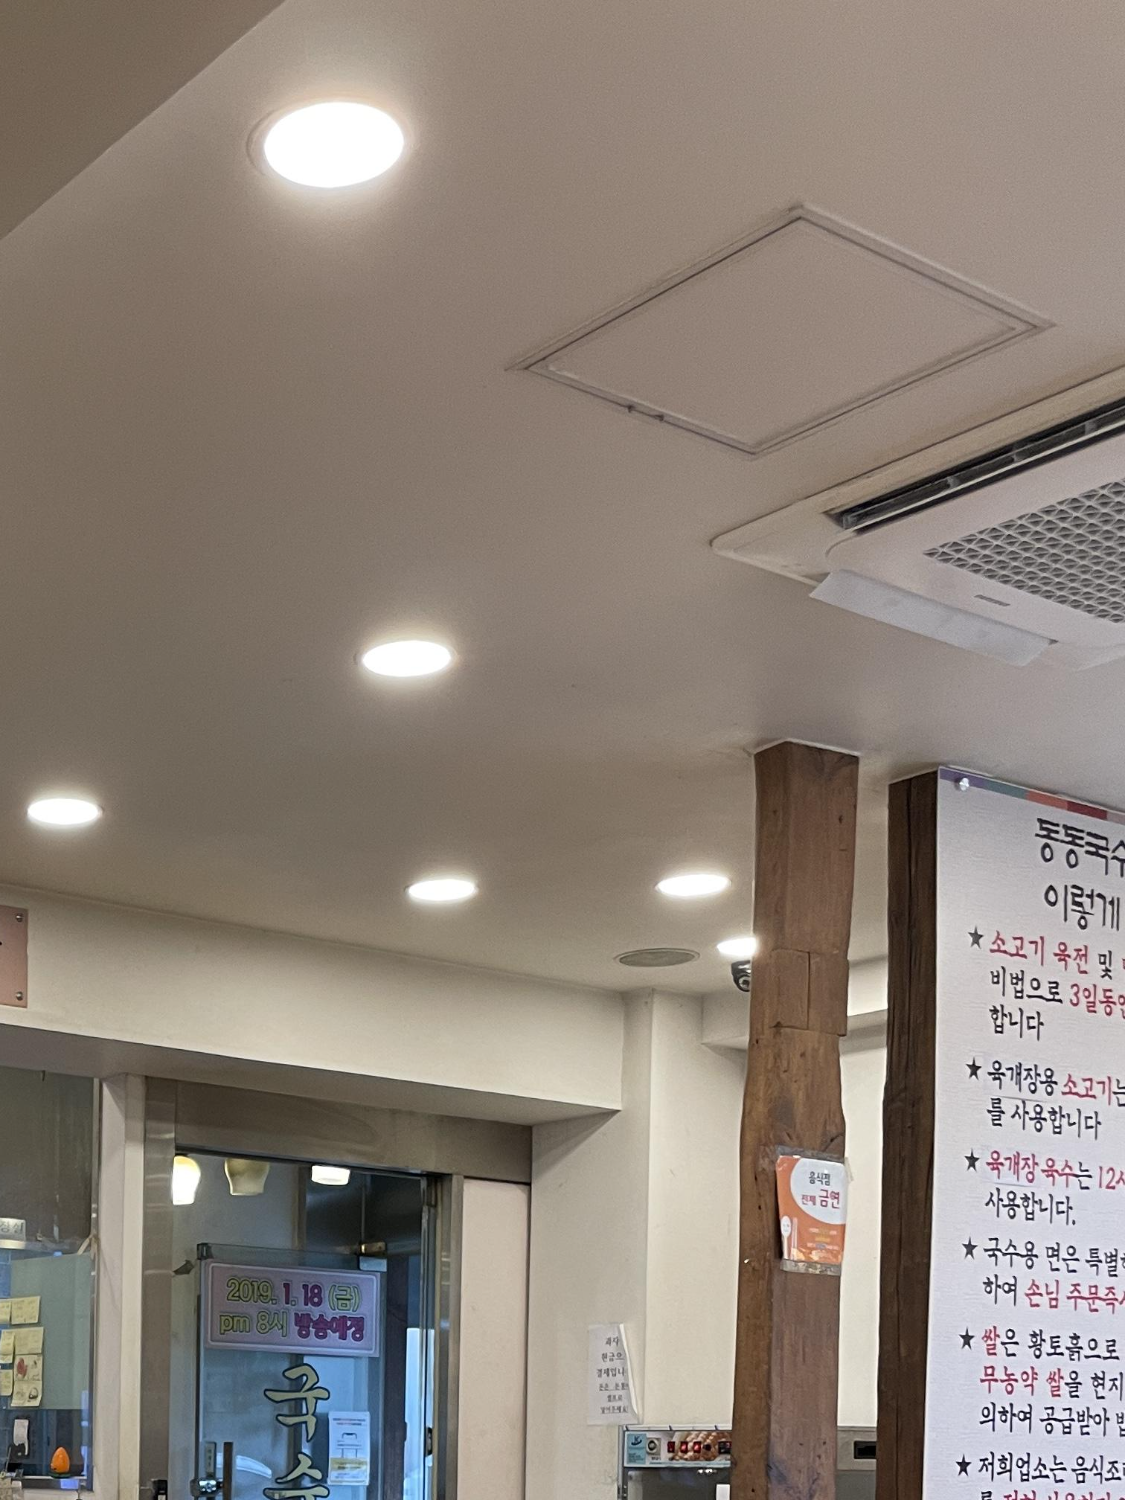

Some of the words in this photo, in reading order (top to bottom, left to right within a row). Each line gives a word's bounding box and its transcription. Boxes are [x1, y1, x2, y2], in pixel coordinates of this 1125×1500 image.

[1044, 884, 1121, 931] 이렇게
[990, 930, 1045, 967] 소고기
[1053, 941, 1090, 975] 육전
[1098, 950, 1113, 981] 및
[990, 966, 1063, 1004] 비법으로
[989, 1003, 1045, 1041] 합니다
[987, 1059, 1059, 1097] 육개장용
[1061, 1073, 1125, 1108] 소고기는
[987, 1097, 1006, 1127] 를
[1011, 1100, 1102, 1141] 사용합니다
[986, 1150, 1039, 1184] 육개장
[1041, 1157, 1093, 1191] 육수는
[985, 1187, 1077, 1226] 사용합니다.
[983, 1237, 1039, 1270] 국수용
[1045, 1242, 1080, 1274] 면은
[301, 1283, 323, 1308] 18
[328, 1283, 362, 1313] (금)
[983, 1274, 1017, 1307] 하여
[1025, 1279, 1060, 1310] 손님
[219, 1314, 251, 1336] pm
[256, 1311, 288, 1338] 8시
[294, 1312, 366, 1342] 방송예정
[981, 1326, 1020, 1358] 쌀은
[1028, 1329, 1120, 1362] 황토흙으로
[596, 1367, 625, 1378] 결제입니
[979, 1365, 1038, 1397] 무농약
[1046, 1368, 1083, 1399] 쌀을
[1090, 1370, 1124, 1402] 현지
[979, 1401, 1033, 1435] 의하여
[1040, 1405, 1111, 1438] 공급받아
[1071, 1454, 1125, 1486] 음식조
